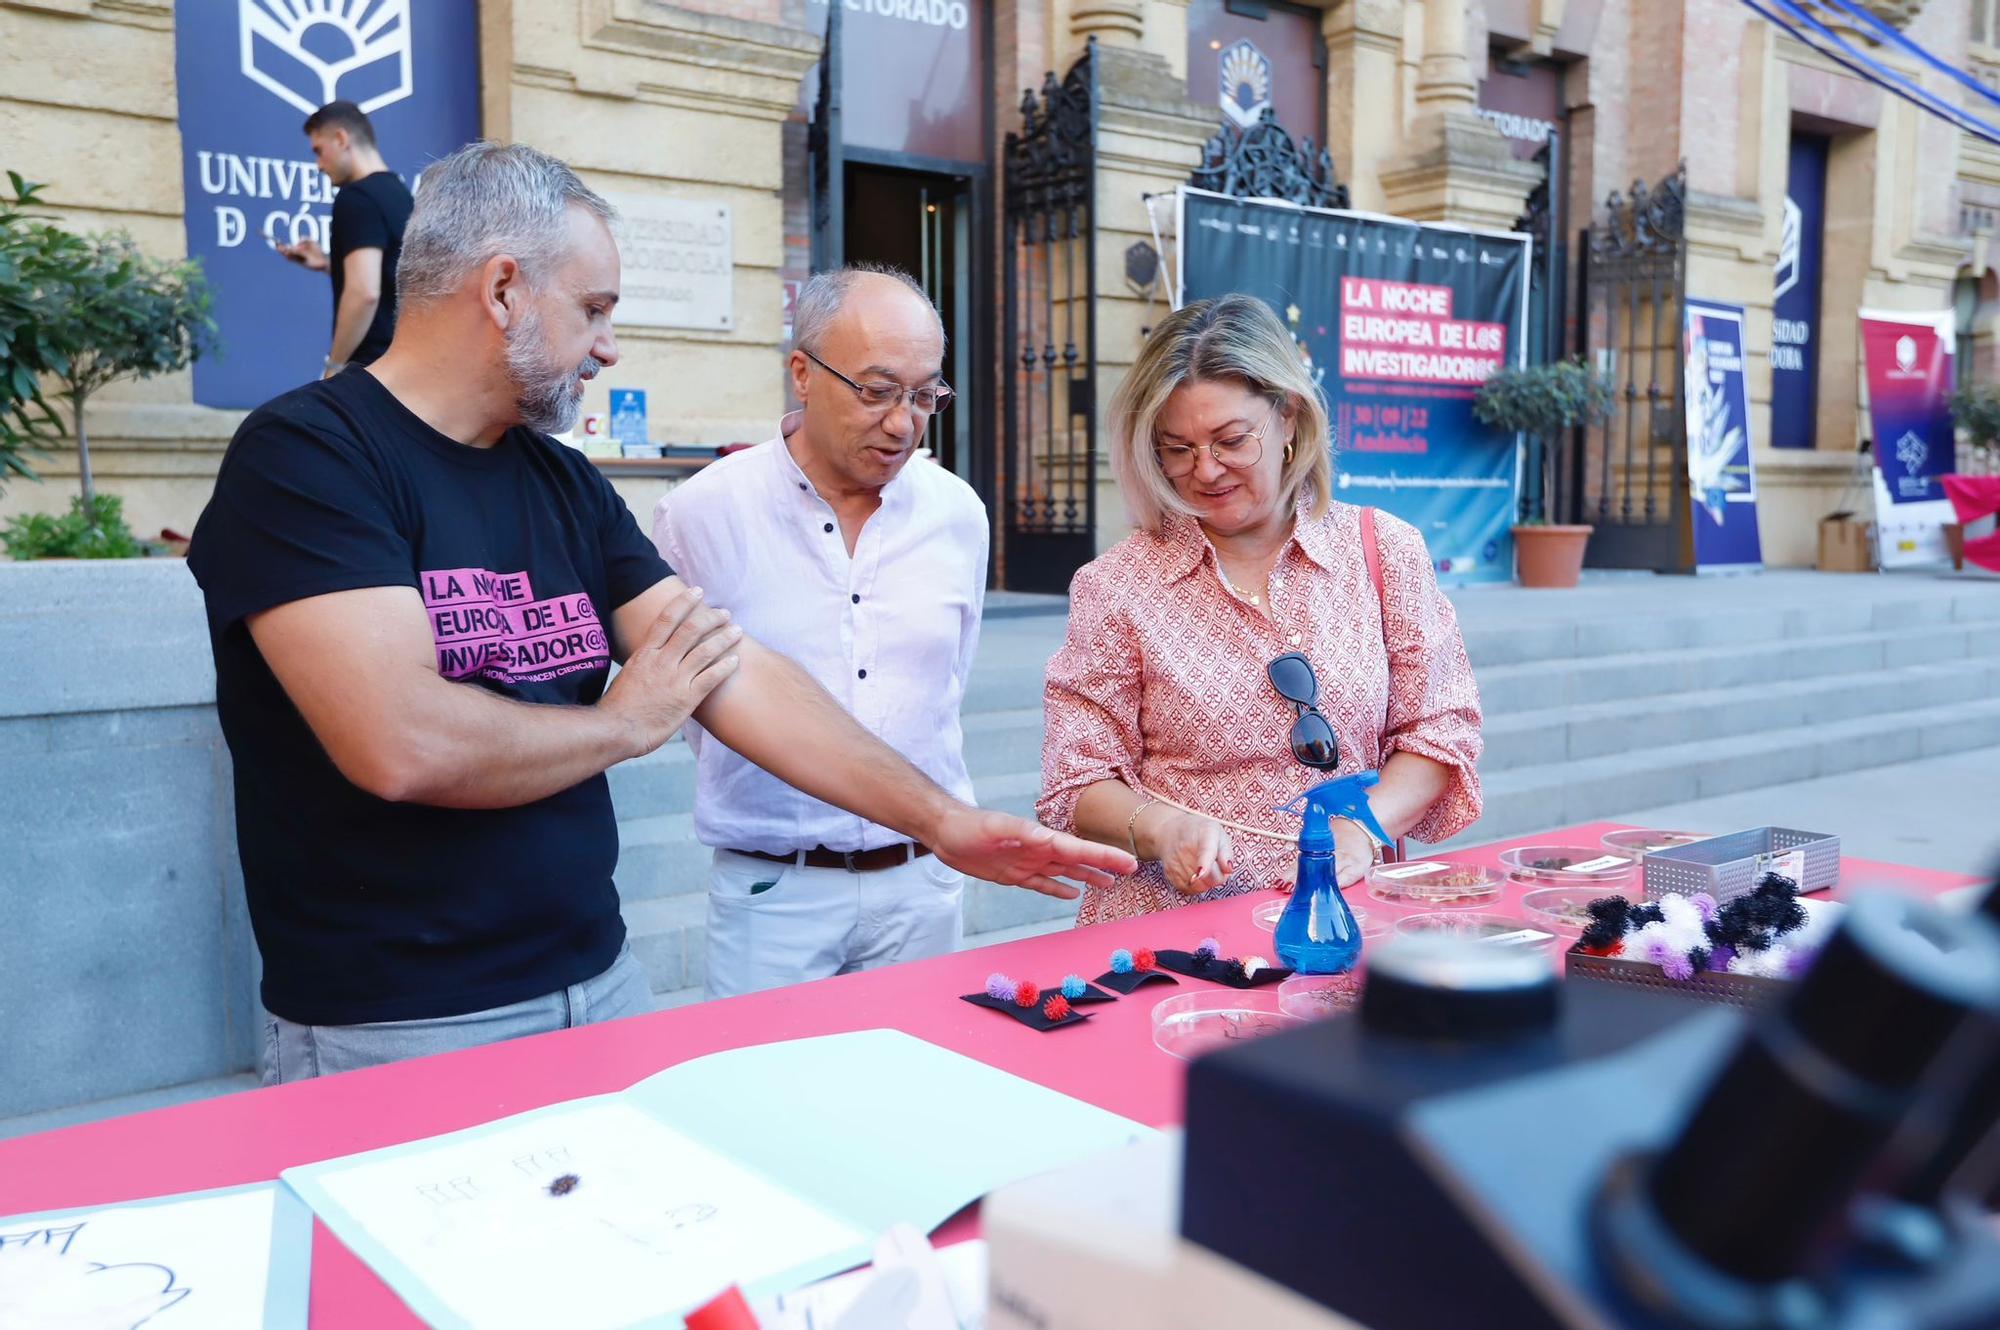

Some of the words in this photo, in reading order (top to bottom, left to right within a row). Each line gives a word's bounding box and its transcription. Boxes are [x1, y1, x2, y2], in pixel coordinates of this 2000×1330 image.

[1345, 281, 1373, 308] LA
[1381, 286, 1448, 316] NOCHE
[1344, 315, 1434, 346] EUROPEA
[1439, 323, 1463, 348] DE
[428, 575, 465, 600] LA
[522, 606, 556, 632] DE
[556, 661, 595, 676] CIENCIA
